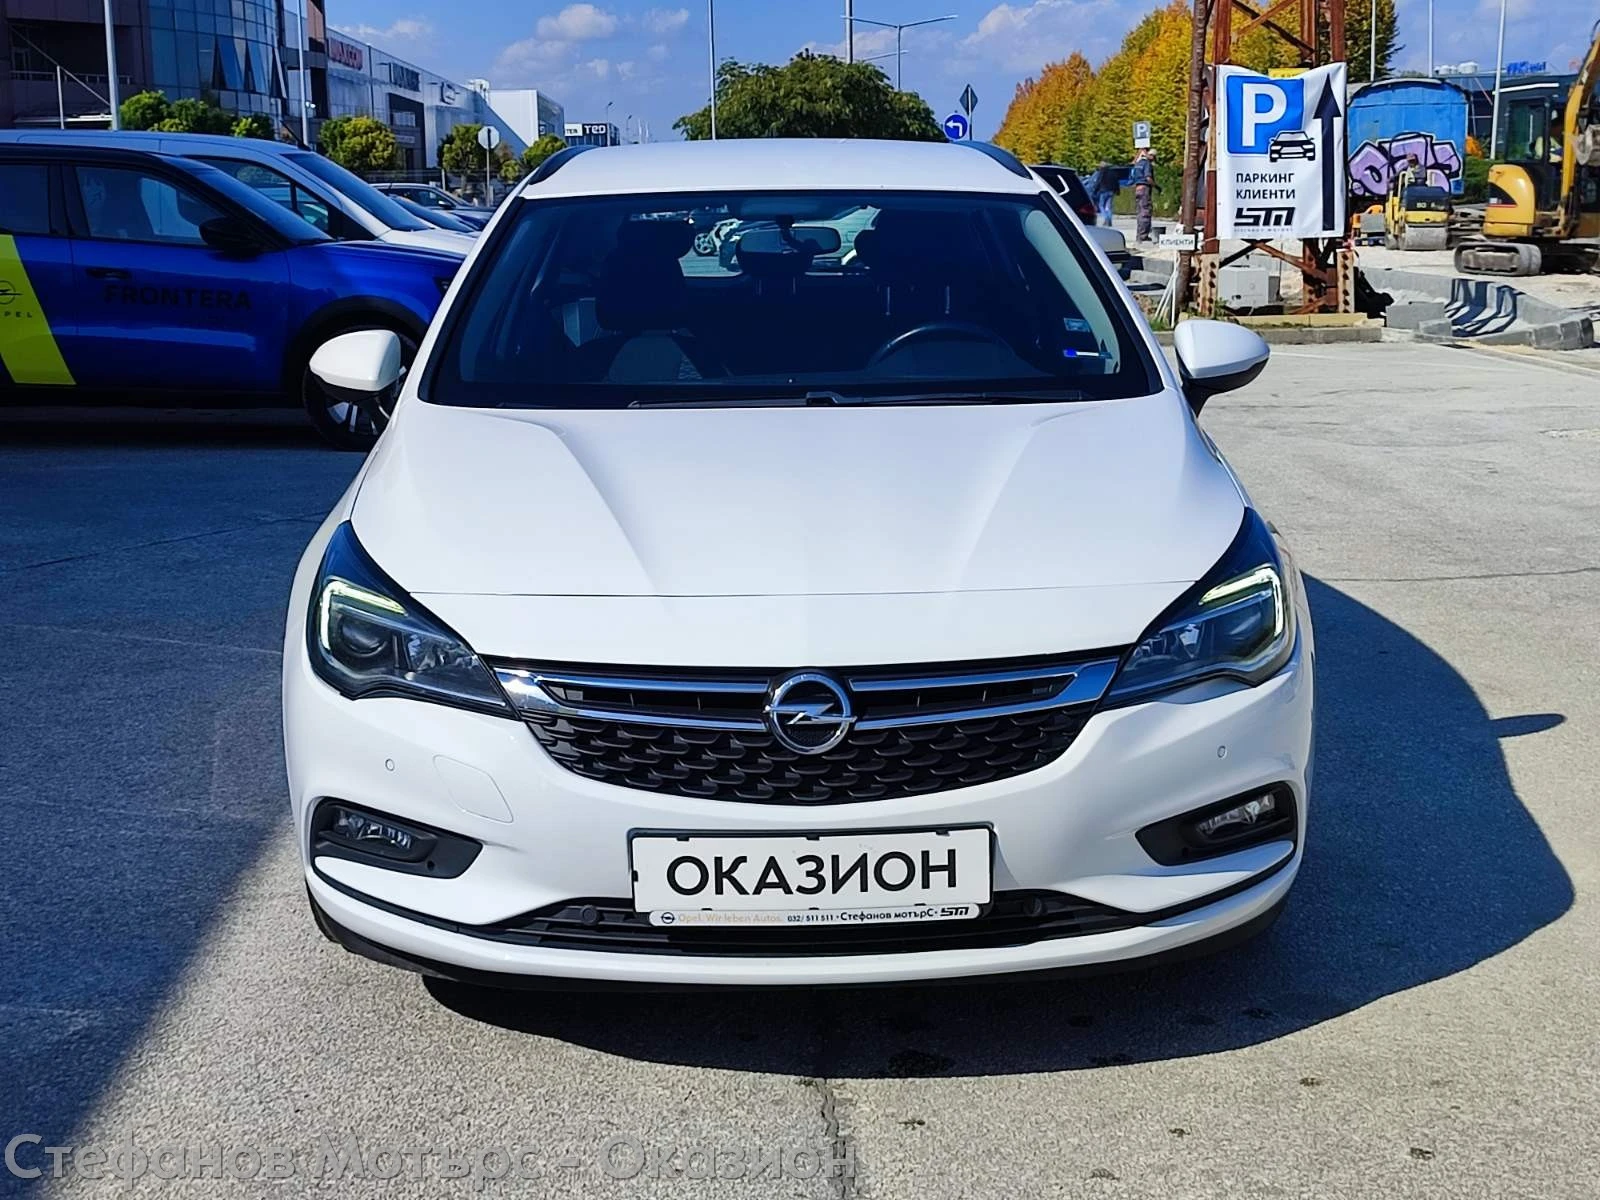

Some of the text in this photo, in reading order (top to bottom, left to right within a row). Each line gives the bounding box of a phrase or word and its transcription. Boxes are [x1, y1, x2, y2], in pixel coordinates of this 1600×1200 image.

[1242, 83, 1287, 147] P
[1136, 123, 1147, 137] P
[1236, 172, 1295, 184] ПАРКИНГ
[1236, 188, 1296, 200] КЛИЕНТИ
[1234, 207, 1296, 226] STM
[103, 284, 252, 310] FRONTERA
[667, 848, 957, 897] ОКАЗИОН
[806, 914, 819, 922] 511
[821, 914, 834, 922] 511
[840, 910, 892, 923] Стефанов
